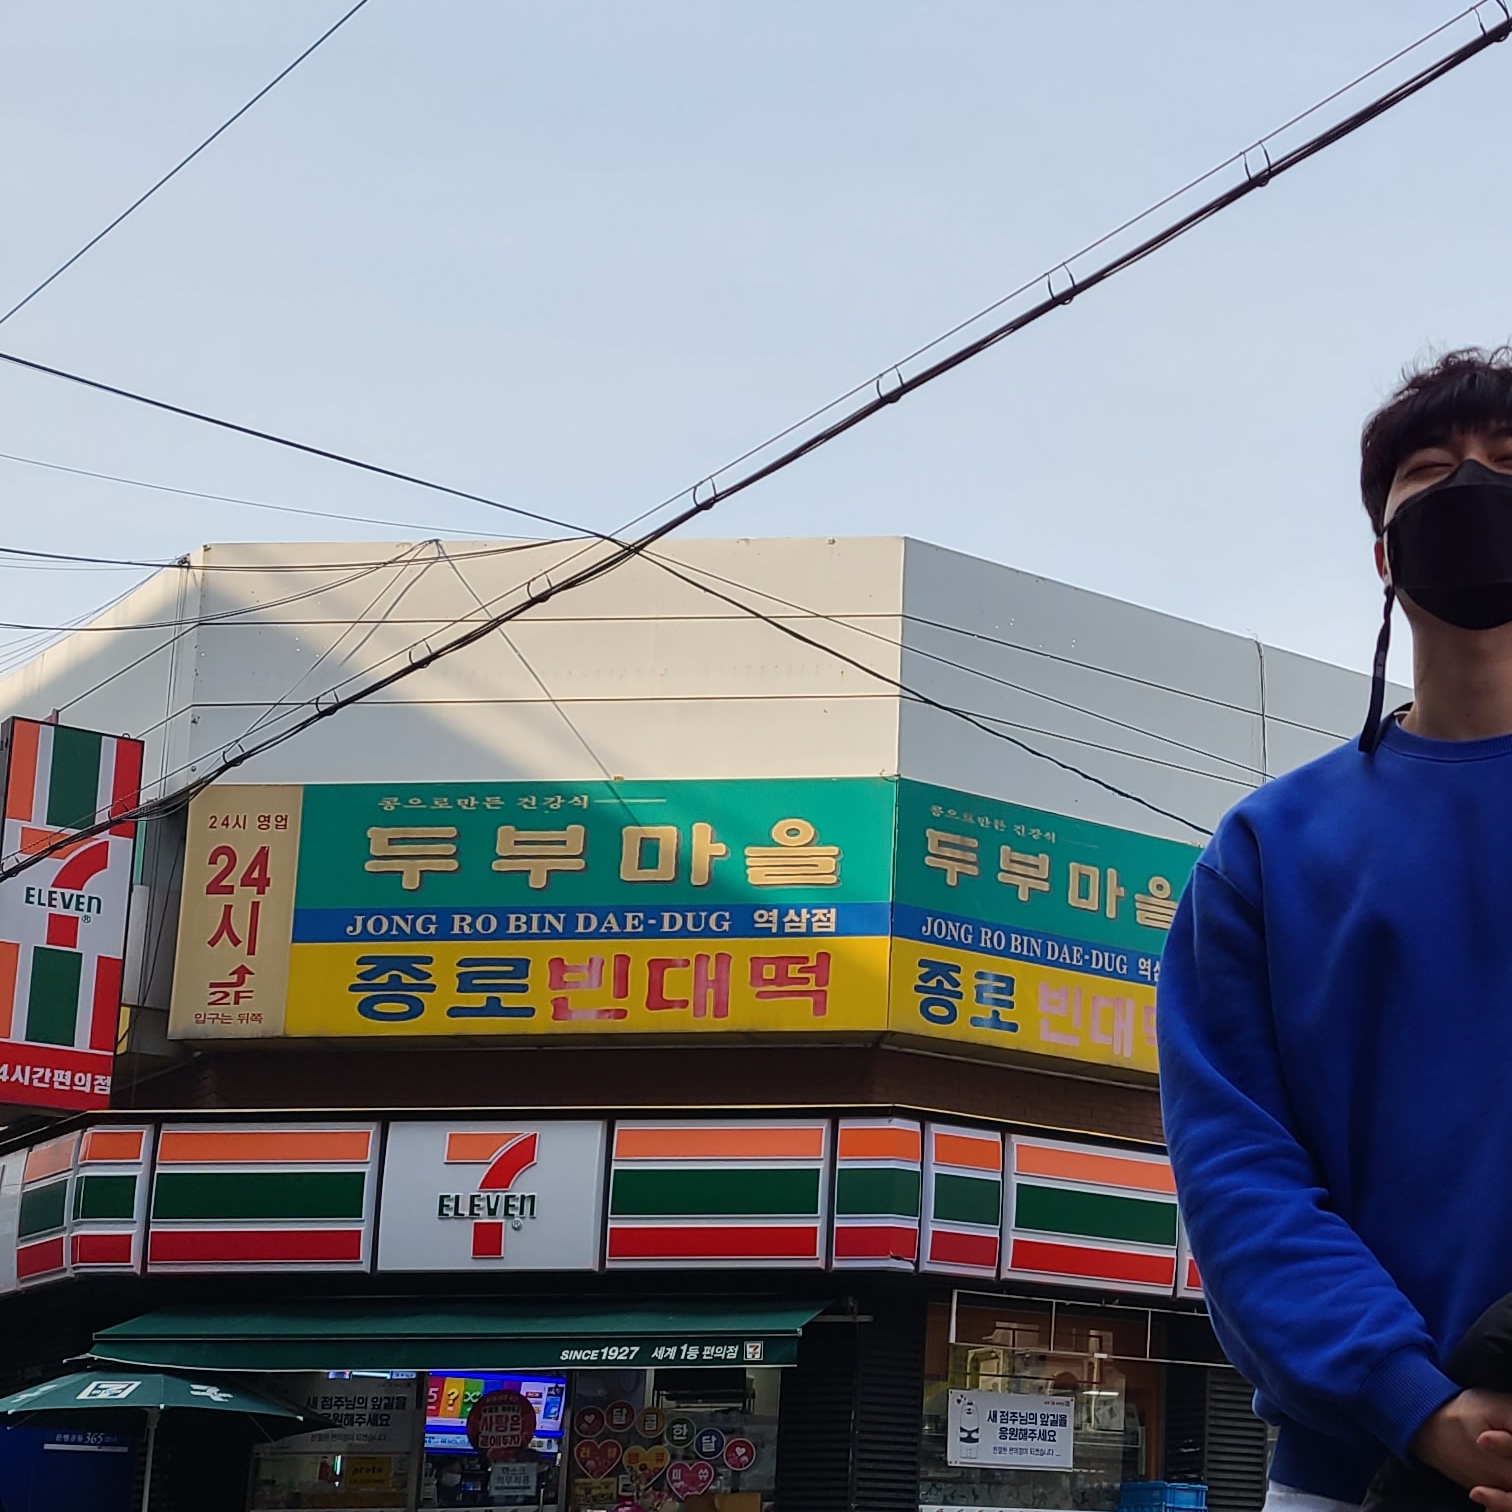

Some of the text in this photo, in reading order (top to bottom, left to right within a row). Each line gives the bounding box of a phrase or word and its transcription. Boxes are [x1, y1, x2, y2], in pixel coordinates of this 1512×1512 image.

[517, 795, 589, 810] 건강식
[209, 813, 289, 830] 24시 영업
[365, 819, 842, 890] 두부마을
[346, 907, 837, 937] JONG RO BIN DAE-DUG 역삼점
[922, 916, 974, 944] JONG
[979, 927, 1006, 950] RO
[1010, 934, 1042, 958] BIN
[1046, 941, 1129, 975] DAE-DUG
[348, 951, 831, 1022] 종로빈대떡
[207, 990, 254, 1006] 2F
[194, 1012, 264, 1025] 입구는 뒤쪽
[560, 1348, 599, 1361] SINCE
[600, 1346, 639, 1360] 1927
[651, 1345, 677, 1360] 세계
[702, 1344, 739, 1360] 편의점
[321, 1396, 368, 1410] 점주님의
[371, 1396, 407, 1410] 앞길을
[986, 1410, 1068, 1428] 새 점주님의 앞길을
[998, 1426, 1057, 1442] 응원해주세요
